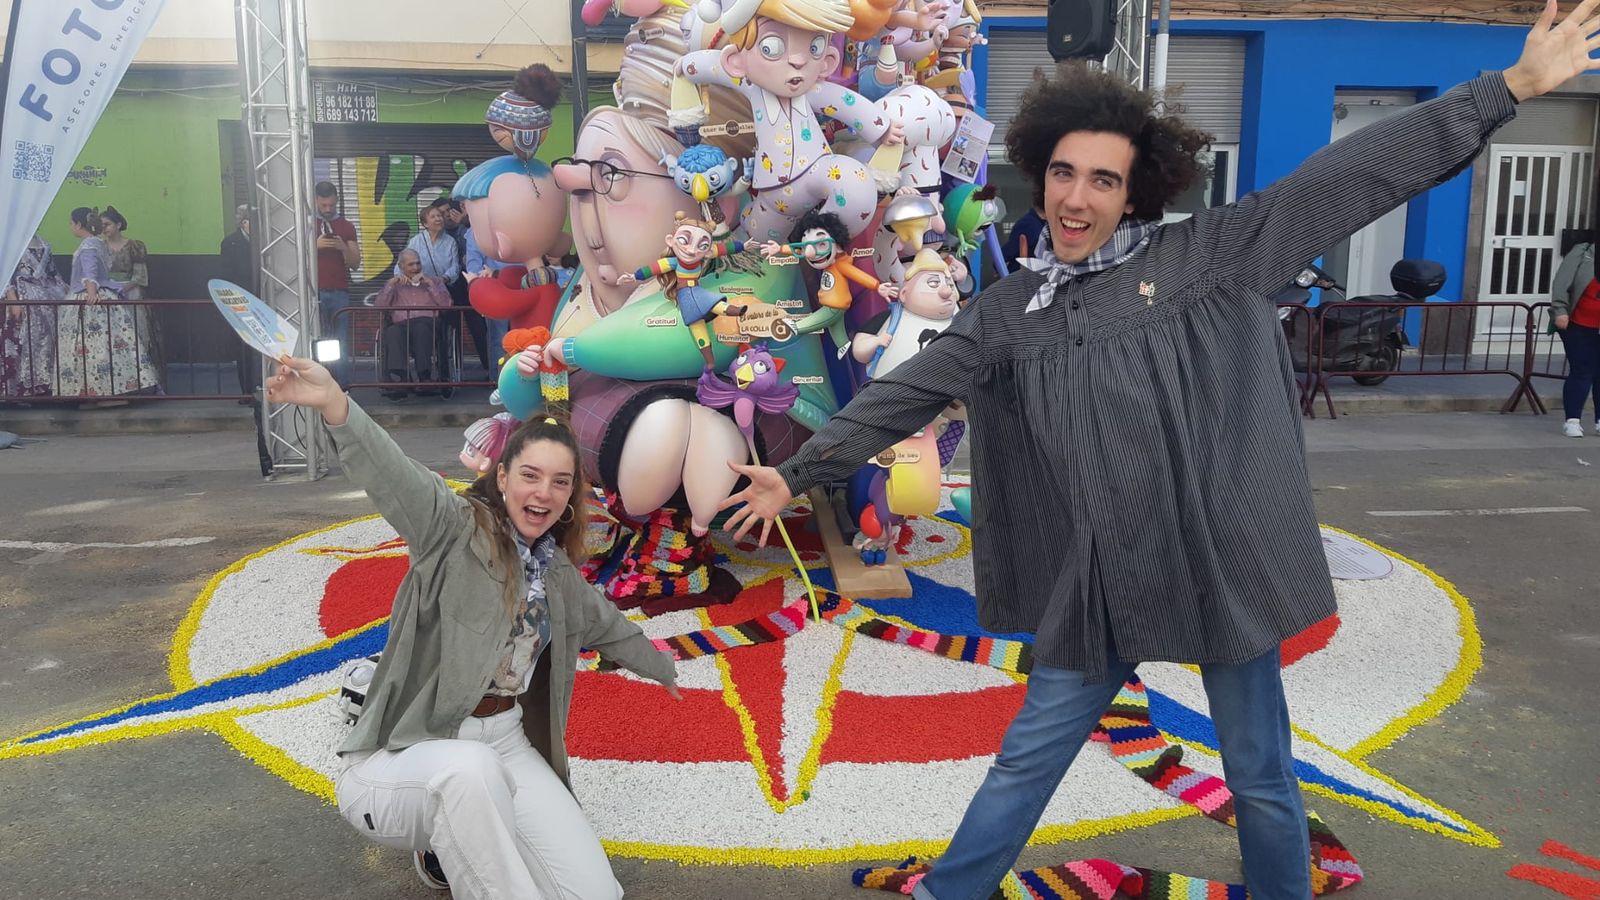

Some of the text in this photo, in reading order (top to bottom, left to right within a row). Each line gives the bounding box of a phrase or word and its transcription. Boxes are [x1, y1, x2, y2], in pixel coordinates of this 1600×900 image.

[19, 0, 124, 121] FOT
[62, 61, 107, 133] ASESORES
[325, 95, 375, 108] 96 182 11 88
[326, 108, 376, 122] 689 143 712
[853, 248, 874, 257] Amor
